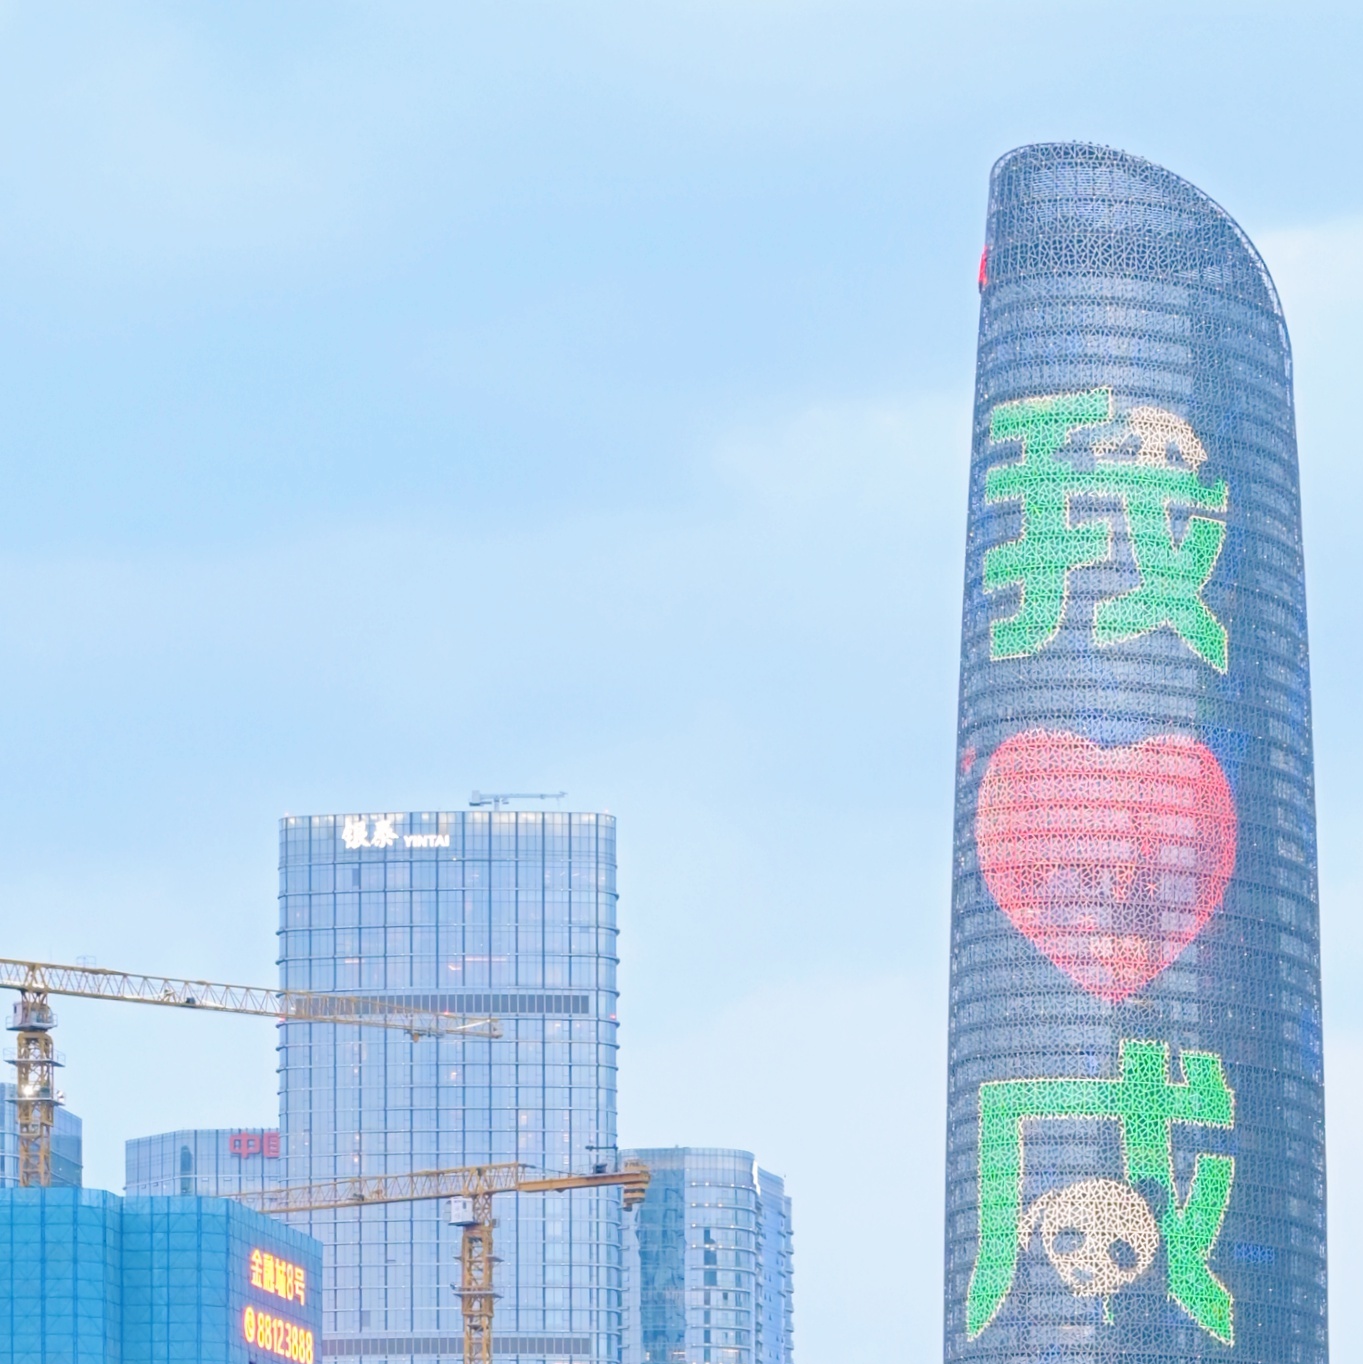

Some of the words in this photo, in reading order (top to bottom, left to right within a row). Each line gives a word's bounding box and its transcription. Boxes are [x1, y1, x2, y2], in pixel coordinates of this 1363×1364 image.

[403, 834, 450, 848] YINTAI
[250, 1248, 305, 1306] 金融城8号
